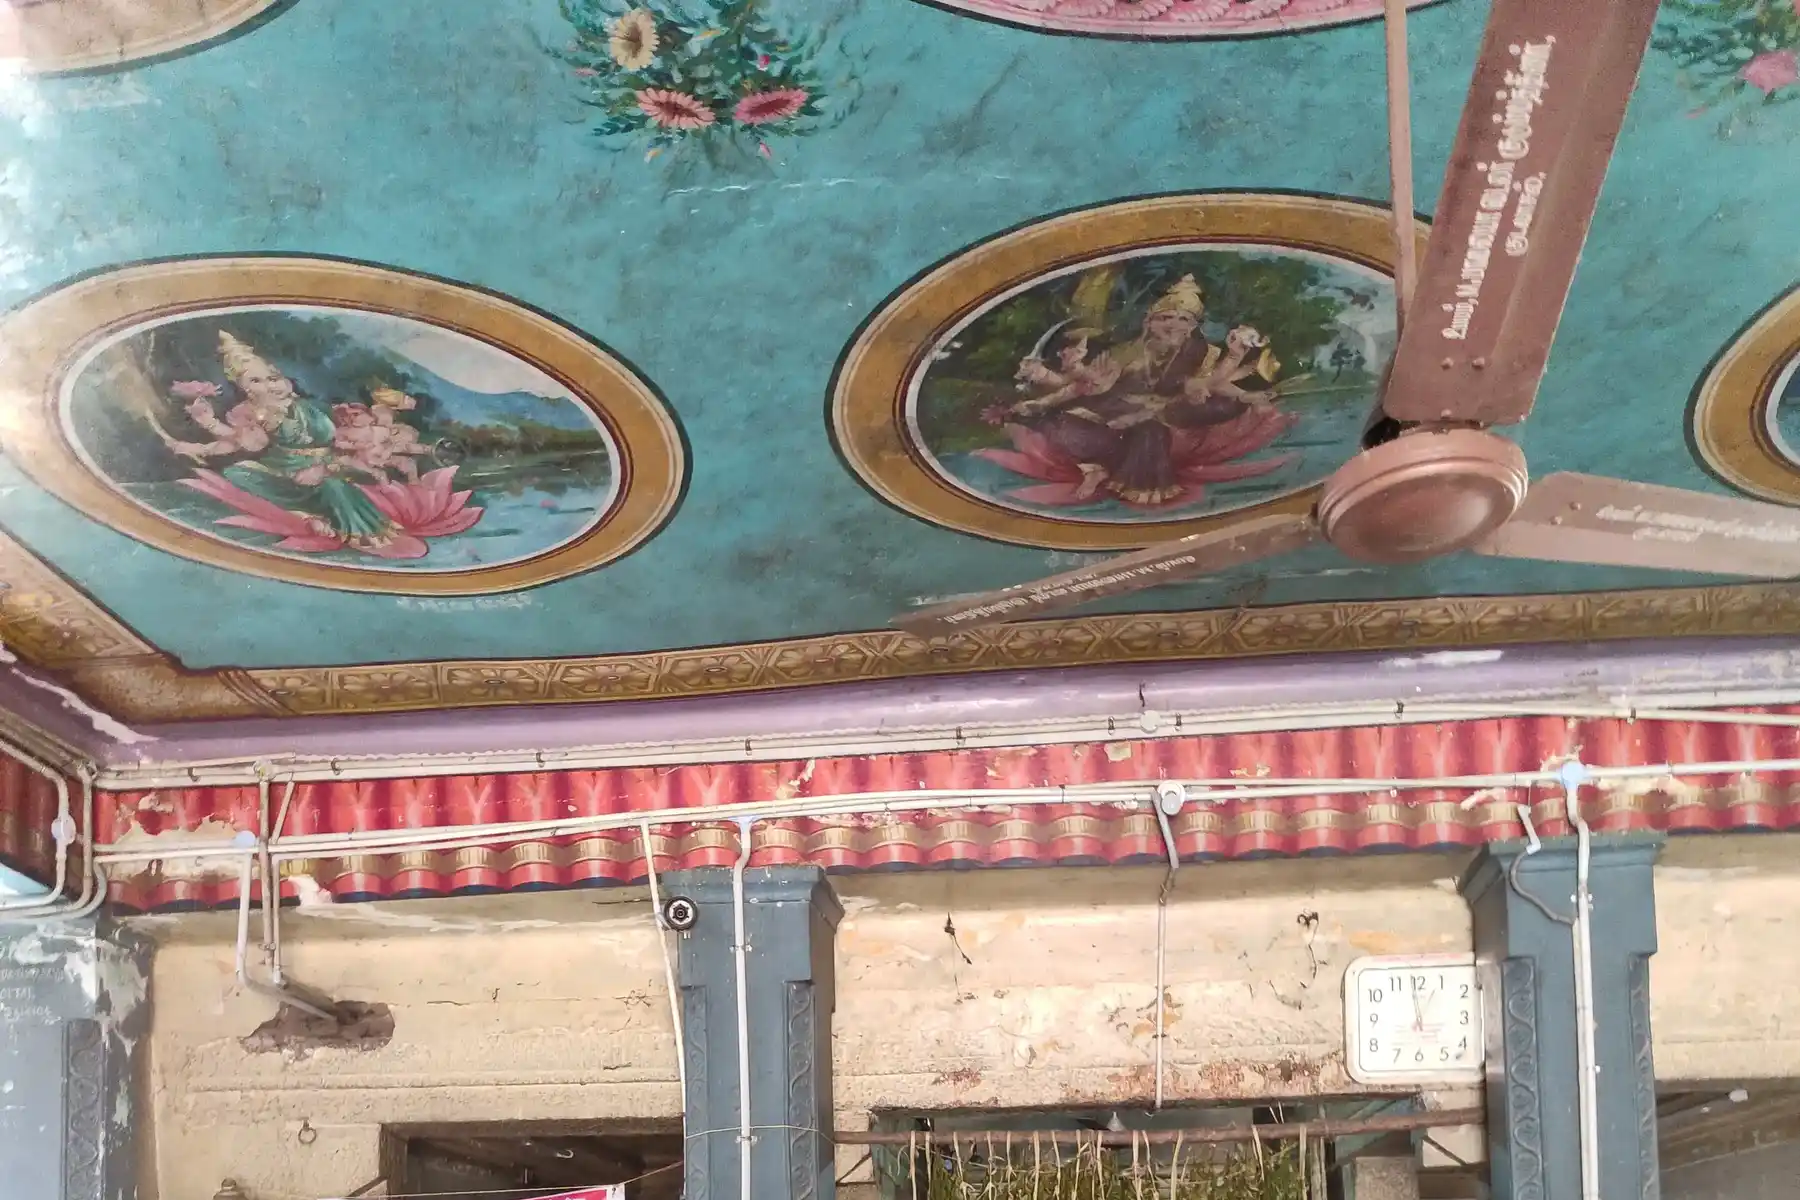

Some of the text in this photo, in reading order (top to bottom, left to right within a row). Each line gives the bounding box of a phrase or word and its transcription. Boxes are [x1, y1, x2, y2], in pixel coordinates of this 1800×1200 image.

[1389, 976, 1402, 992] 11
[1411, 975, 1426, 990] 12
[1439, 974, 1444, 990] 1
[1368, 988, 1383, 1003] 10
[1459, 984, 1469, 999] 2
[1369, 1013, 1379, 1028] 9
[1459, 1010, 1469, 1025] 3
[1369, 1038, 1379, 1052] 8
[1458, 1036, 1467, 1051] 4
[1392, 1048, 1401, 1064] 7
[1414, 1047, 1424, 1062] 6
[1439, 1046, 1449, 1062] 5
